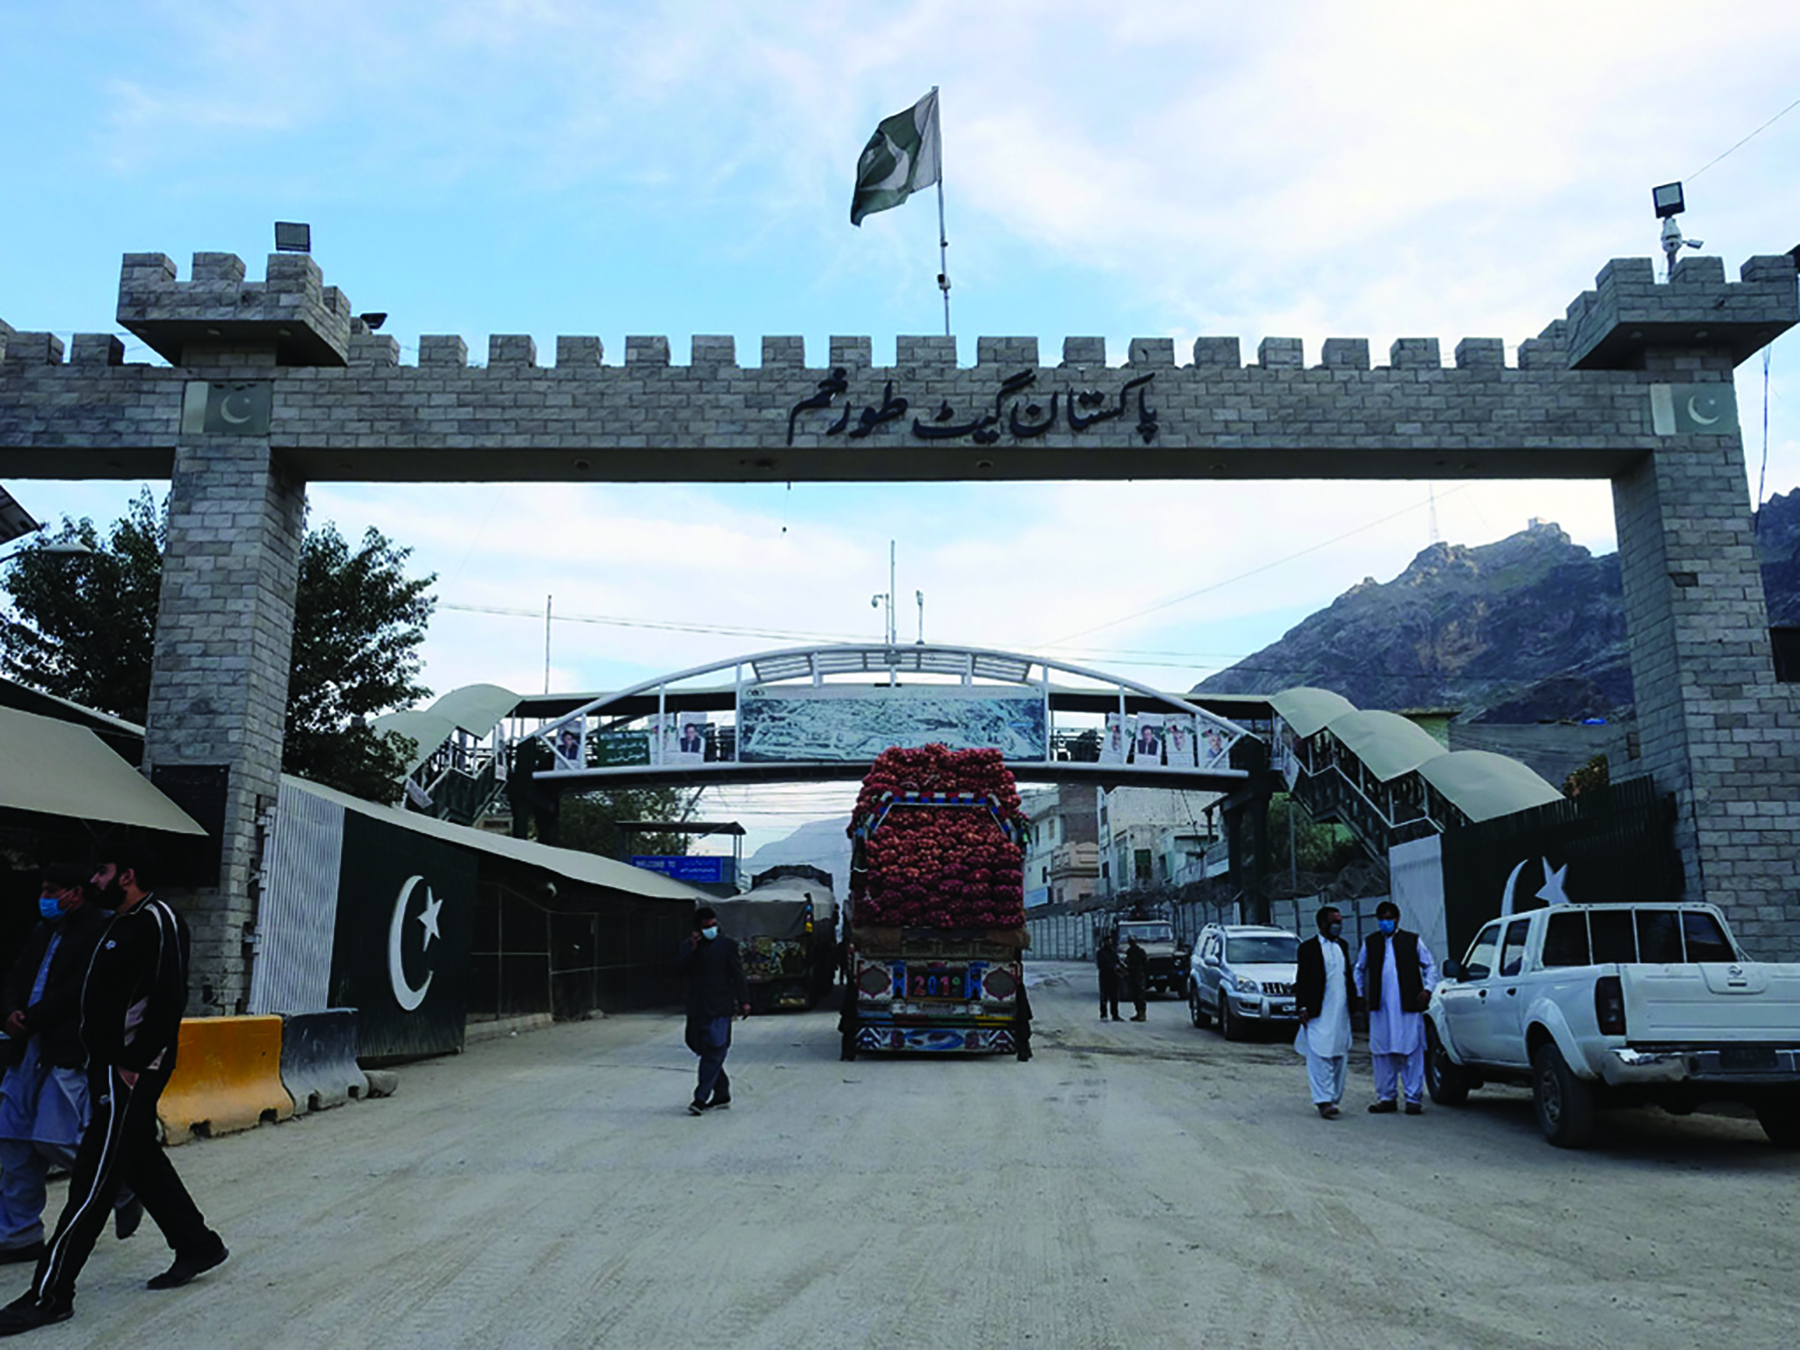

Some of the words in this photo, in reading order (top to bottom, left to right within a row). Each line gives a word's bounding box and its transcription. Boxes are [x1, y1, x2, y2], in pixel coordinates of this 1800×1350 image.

[786, 366, 909, 446] طورخم
[911, 367, 1037, 445] گیٹ
[1009, 371, 1161, 446] پاکستان
